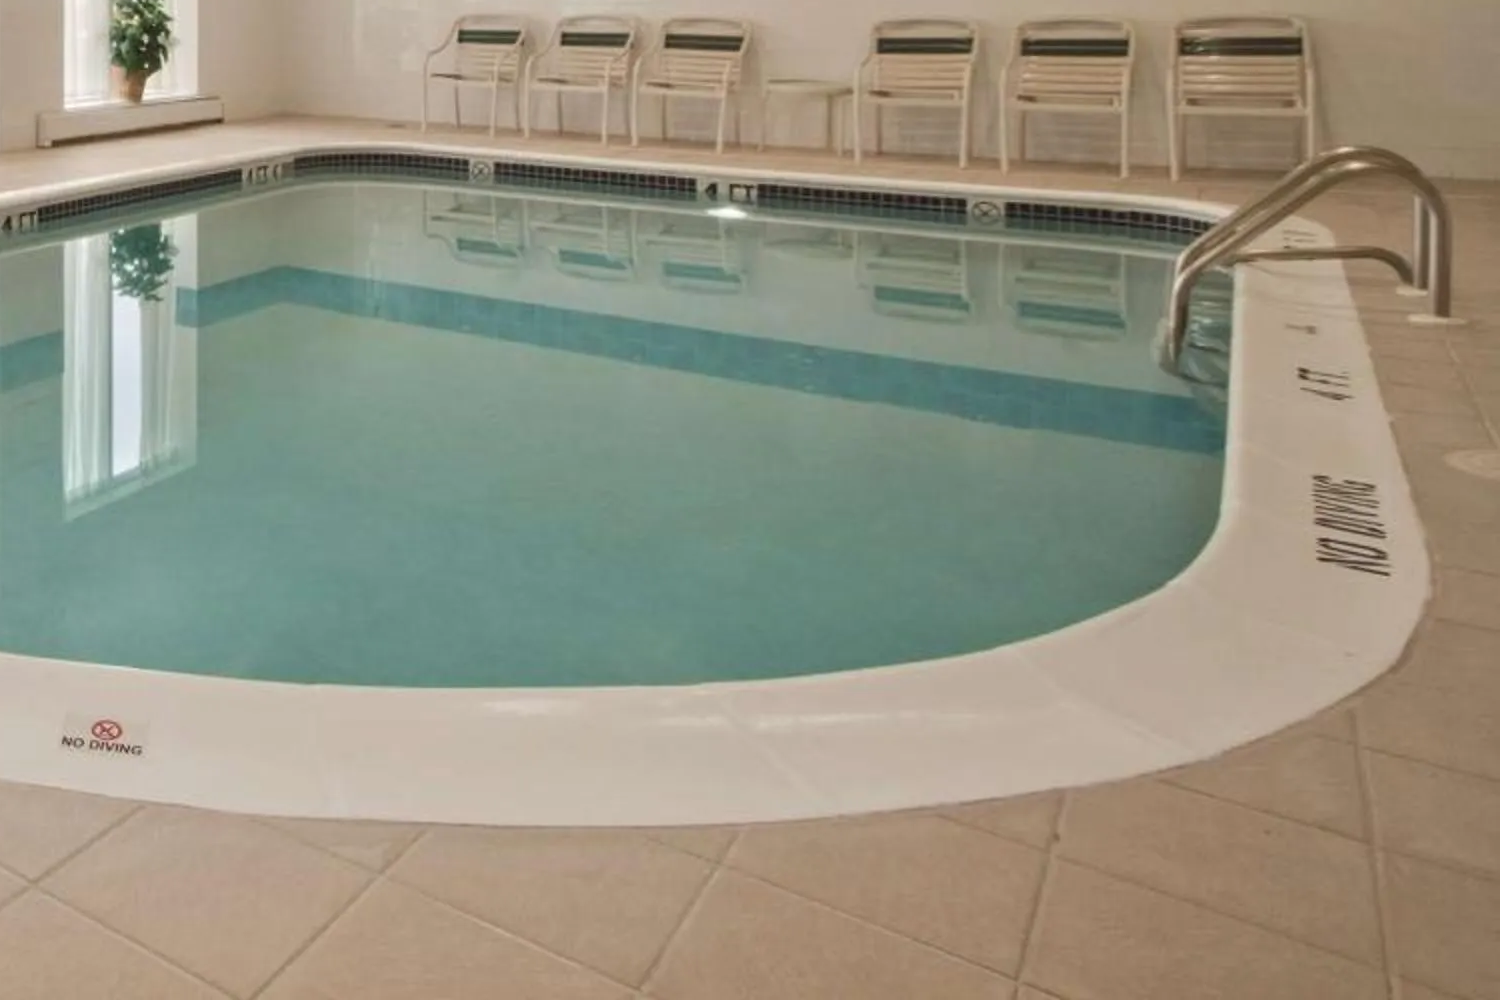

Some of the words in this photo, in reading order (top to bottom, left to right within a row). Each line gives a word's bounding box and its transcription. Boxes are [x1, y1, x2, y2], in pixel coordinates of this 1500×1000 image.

[1311, 475, 1387, 539] DIVING
[1315, 538, 1391, 576] NO
[61, 736, 85, 749] NO
[89, 740, 143, 755] DIVING
